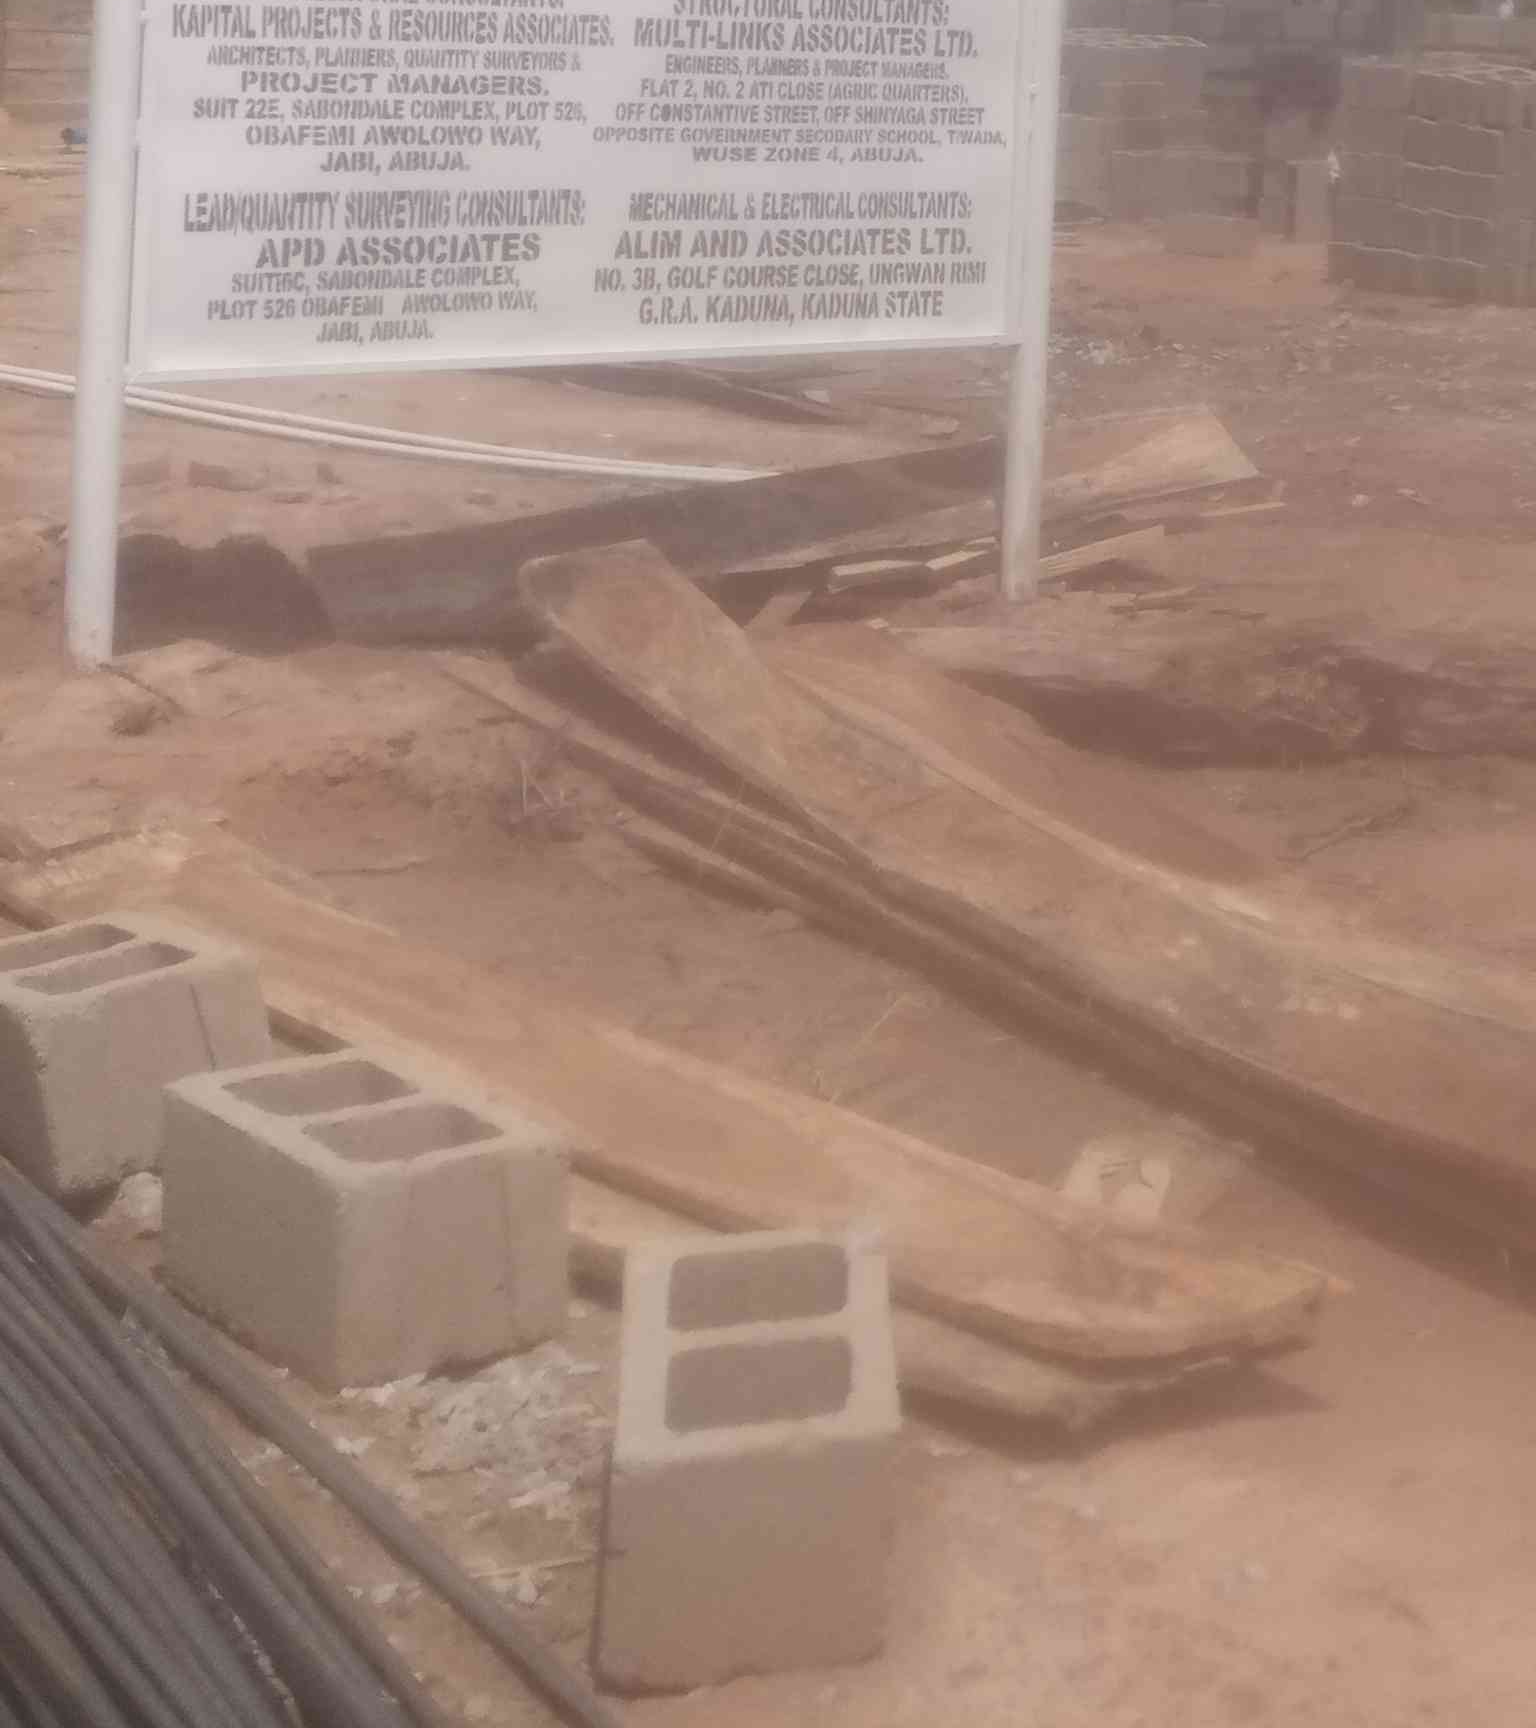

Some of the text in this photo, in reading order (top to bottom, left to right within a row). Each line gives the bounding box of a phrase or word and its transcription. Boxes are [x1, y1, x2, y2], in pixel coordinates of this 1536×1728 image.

[172, 4, 614, 47] KAPITAL PROJECTS & RESOURCES ASSOCIATES.
[633, 18, 978, 59] MULTI-LINKS ASSOCIATES LTD.
[207, 45, 310, 70] ARCHITECTS,
[404, 48, 480, 70] QUANTITY
[483, 50, 568, 72] SURVEYORS
[824, 59, 876, 79] PROJECT
[241, 71, 549, 97] PROJECT MANAGERS.
[640, 78, 677, 99] FLAT
[735, 81, 745, 100] 2
[777, 82, 824, 101] CLOSE
[193, 98, 239, 120] SUIT
[410, 100, 501, 124] COMPLEX,
[505, 101, 550, 121] PLOT
[615, 102, 984, 127] OFF CONSTANTIVE STREET, OFF SHINYAGA STREET
[245, 125, 541, 151] OBAFEMI AWOLOWO WAY,
[593, 126, 677, 144] OPPOSITE
[680, 127, 792, 144] GOVERNMENT
[877, 128, 942, 147] SCHOOL,
[320, 151, 470, 176] JABI, ABUJA.
[692, 147, 757, 163] WUSE
[764, 146, 820, 163] ZONE
[851, 146, 924, 163] ABUJA.
[344, 189, 451, 231] SURVEYING
[456, 188, 585, 227] CONSULTANTS:
[628, 190, 973, 221] MECHANICAL & ELECTRICAL CONSULTANTS:
[256, 232, 541, 269] APD ASSOCIATES
[614, 227, 972, 260] ALIM AND ASSOCIATES LTD.
[431, 266, 520, 289] COMPLEX,
[667, 265, 716, 289] GOLF
[722, 264, 799, 289] COURSE
[803, 262, 864, 290] CLOSE,
[869, 261, 945, 286] UNGWAN
[207, 298, 258, 320] PLOT
[263, 297, 296, 319] 526
[401, 292, 493, 314] AWOLOWO
[706, 294, 794, 328] KADUNA,
[801, 291, 878, 320] KADUNA
[885, 290, 943, 318] STATE
[316, 319, 433, 345] JABI, ABUJA.
